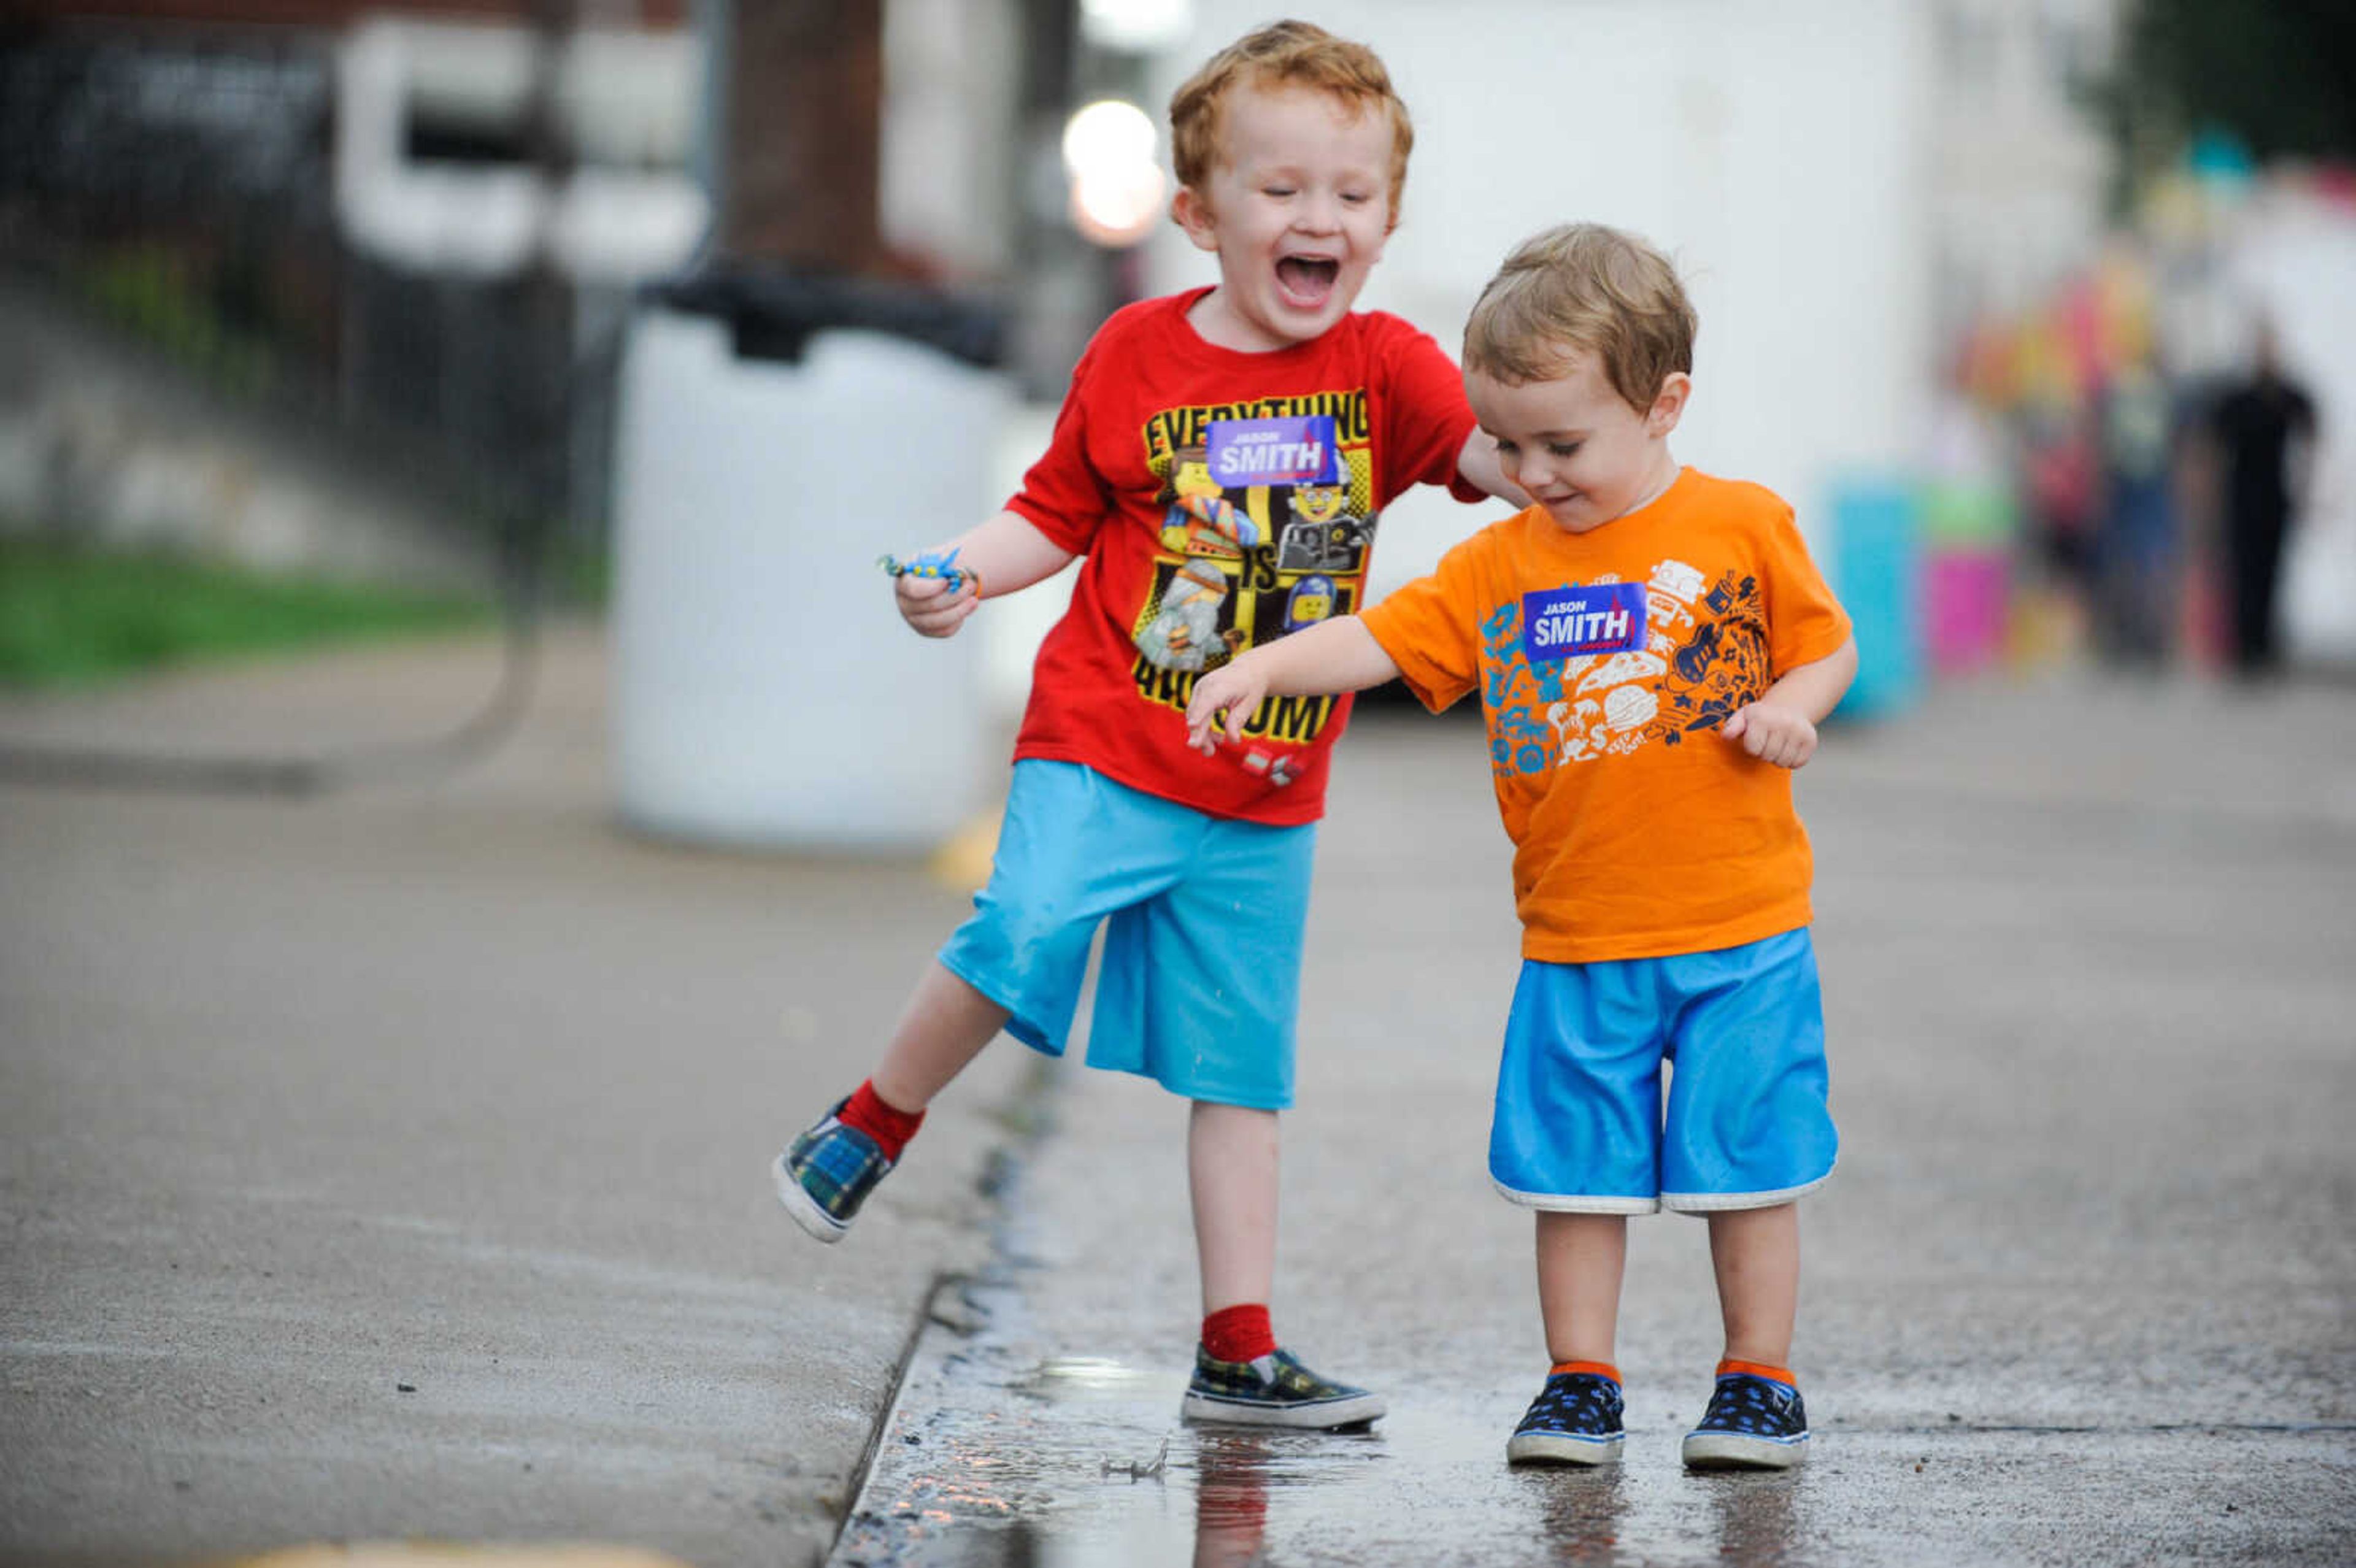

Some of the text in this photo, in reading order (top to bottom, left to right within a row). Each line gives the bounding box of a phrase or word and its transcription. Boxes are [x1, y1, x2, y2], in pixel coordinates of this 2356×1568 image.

[1219, 442, 1322, 475] SMITH
[1242, 545, 1276, 589] IS
[1543, 601, 1587, 616] JASON
[1535, 610, 1629, 647] SMITH
